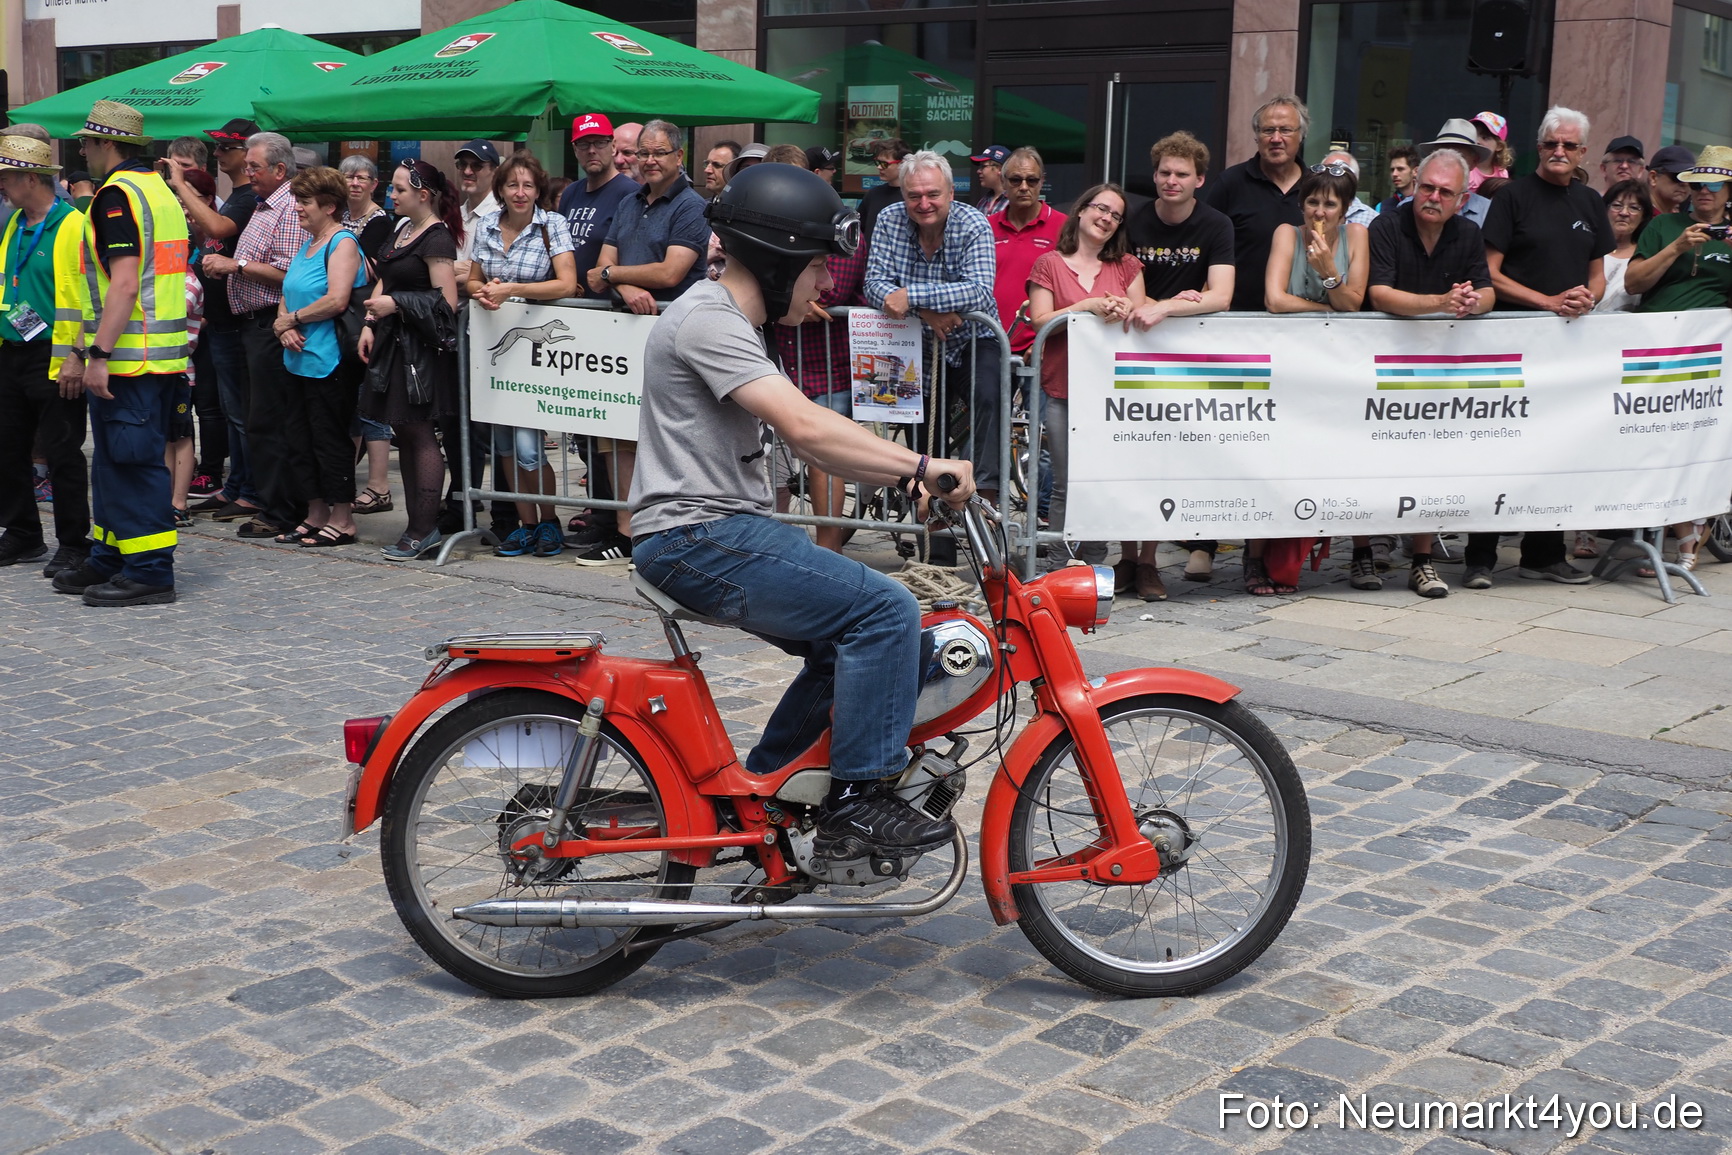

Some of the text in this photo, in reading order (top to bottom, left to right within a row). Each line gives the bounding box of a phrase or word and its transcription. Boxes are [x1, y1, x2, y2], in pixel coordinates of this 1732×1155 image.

[386, 60, 480, 73] Neumarkter
[614, 57, 703, 70] Neumarkter
[350, 67, 480, 86] Lammsbräu
[612, 64, 736, 82] Lammsbräu
[124, 87, 205, 96] Neumarkter
[927, 92, 975, 109] MÄNNER
[851, 104, 895, 118] OLDTIMER
[579, 121, 600, 131] DEKRA
[851, 312, 889, 320] Modellauto
[876, 321, 909, 330] Oldtimer-
[851, 330, 893, 339] Ausstellung
[531, 342, 629, 376] Express
[490, 376, 643, 406] Interessengemeinscha
[1613, 384, 1723, 415] NeuerMarkt
[537, 400, 607, 421] Neumarkt
[1105, 396, 1277, 422] NeuerMarkt
[1364, 394, 1530, 421] NeuerMarkt
[1371, 427, 1522, 441] einkaufen leben genießen
[1619, 421, 1666, 435] einkaufen
[1670, 420, 1690, 432] leben
[1112, 430, 1270, 444] einkaufen leben genießen
[1181, 498, 1257, 509] Dammstraße 1
[1421, 494, 1466, 506] über 500
[1396, 496, 1416, 519] P
[1418, 507, 1470, 519] Parkplätze
[1507, 503, 1573, 515] NM-Neumarkt
[1180, 512, 1232, 523] Neumarkt
[1242, 511, 1251, 522] d.
[1253, 511, 1275, 522] OPf.
[1320, 511, 1373, 521] 10-20 Uhr
